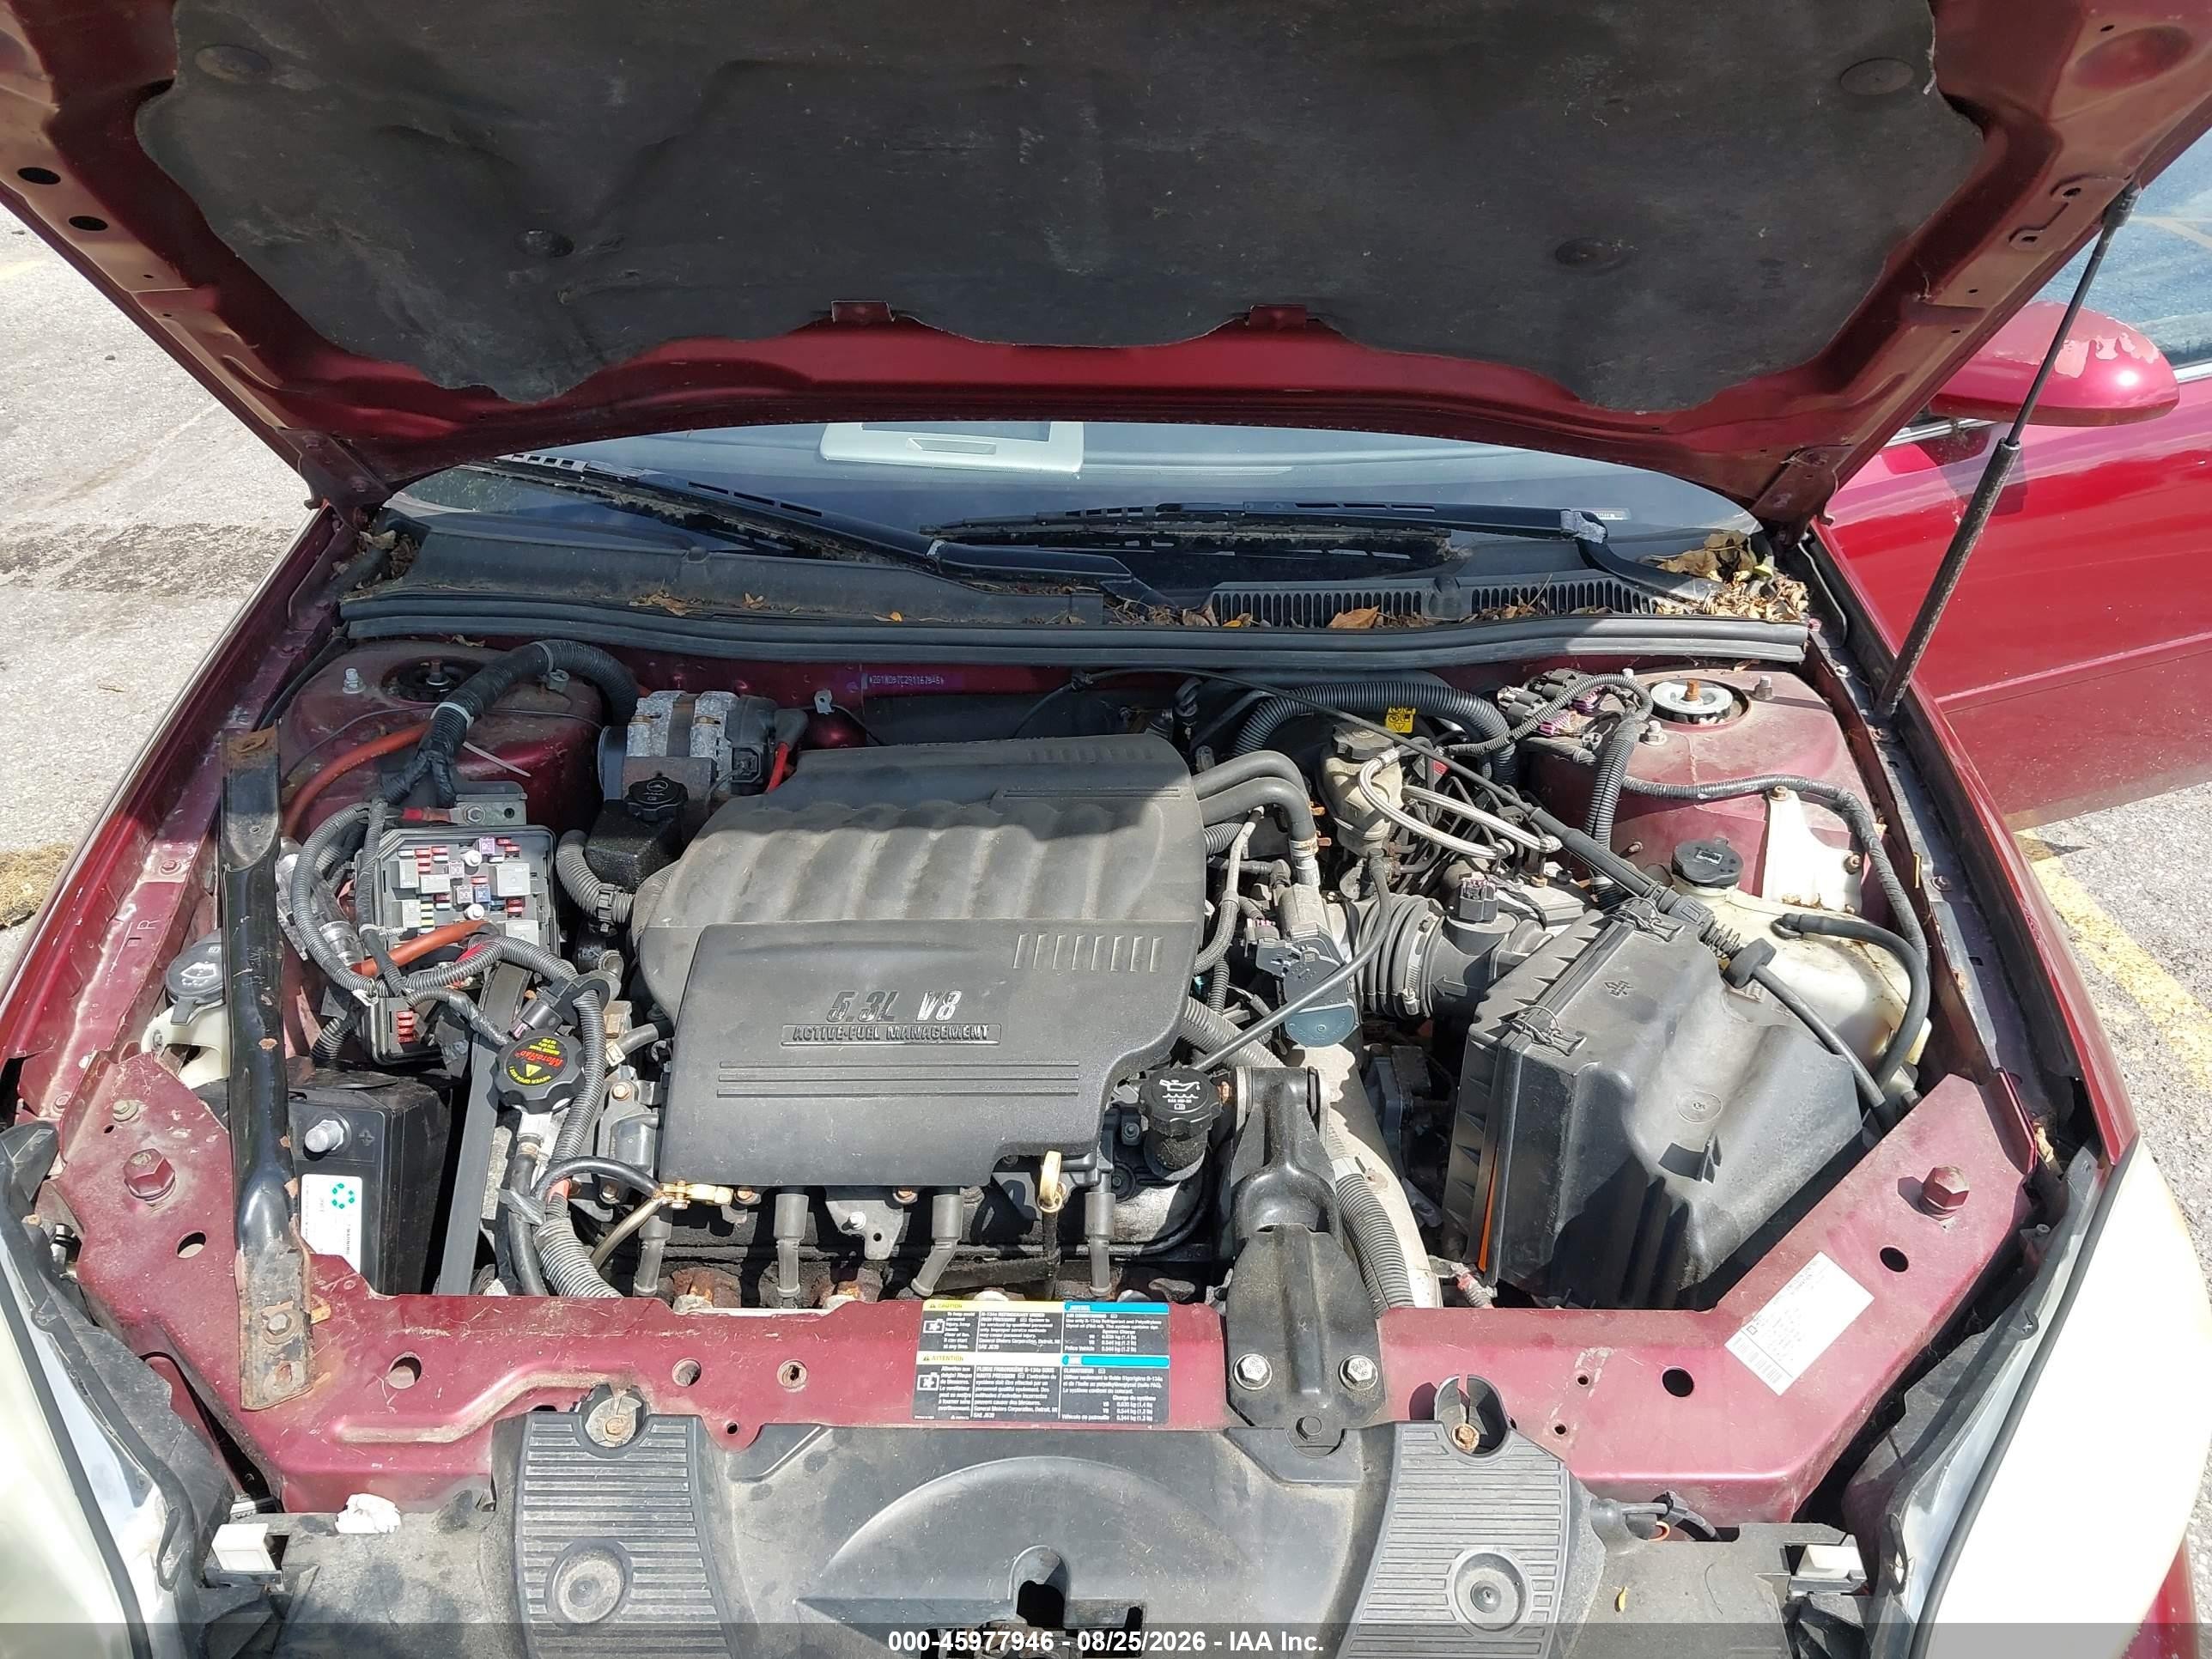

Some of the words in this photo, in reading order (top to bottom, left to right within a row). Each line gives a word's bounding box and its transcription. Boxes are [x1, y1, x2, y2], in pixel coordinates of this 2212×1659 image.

[826, 990, 899, 1023] 5.3L
[916, 990, 962, 1022] V8
[885, 1025, 990, 1040] MANAGEMENT
[531, 1074, 551, 1084] NEVER
